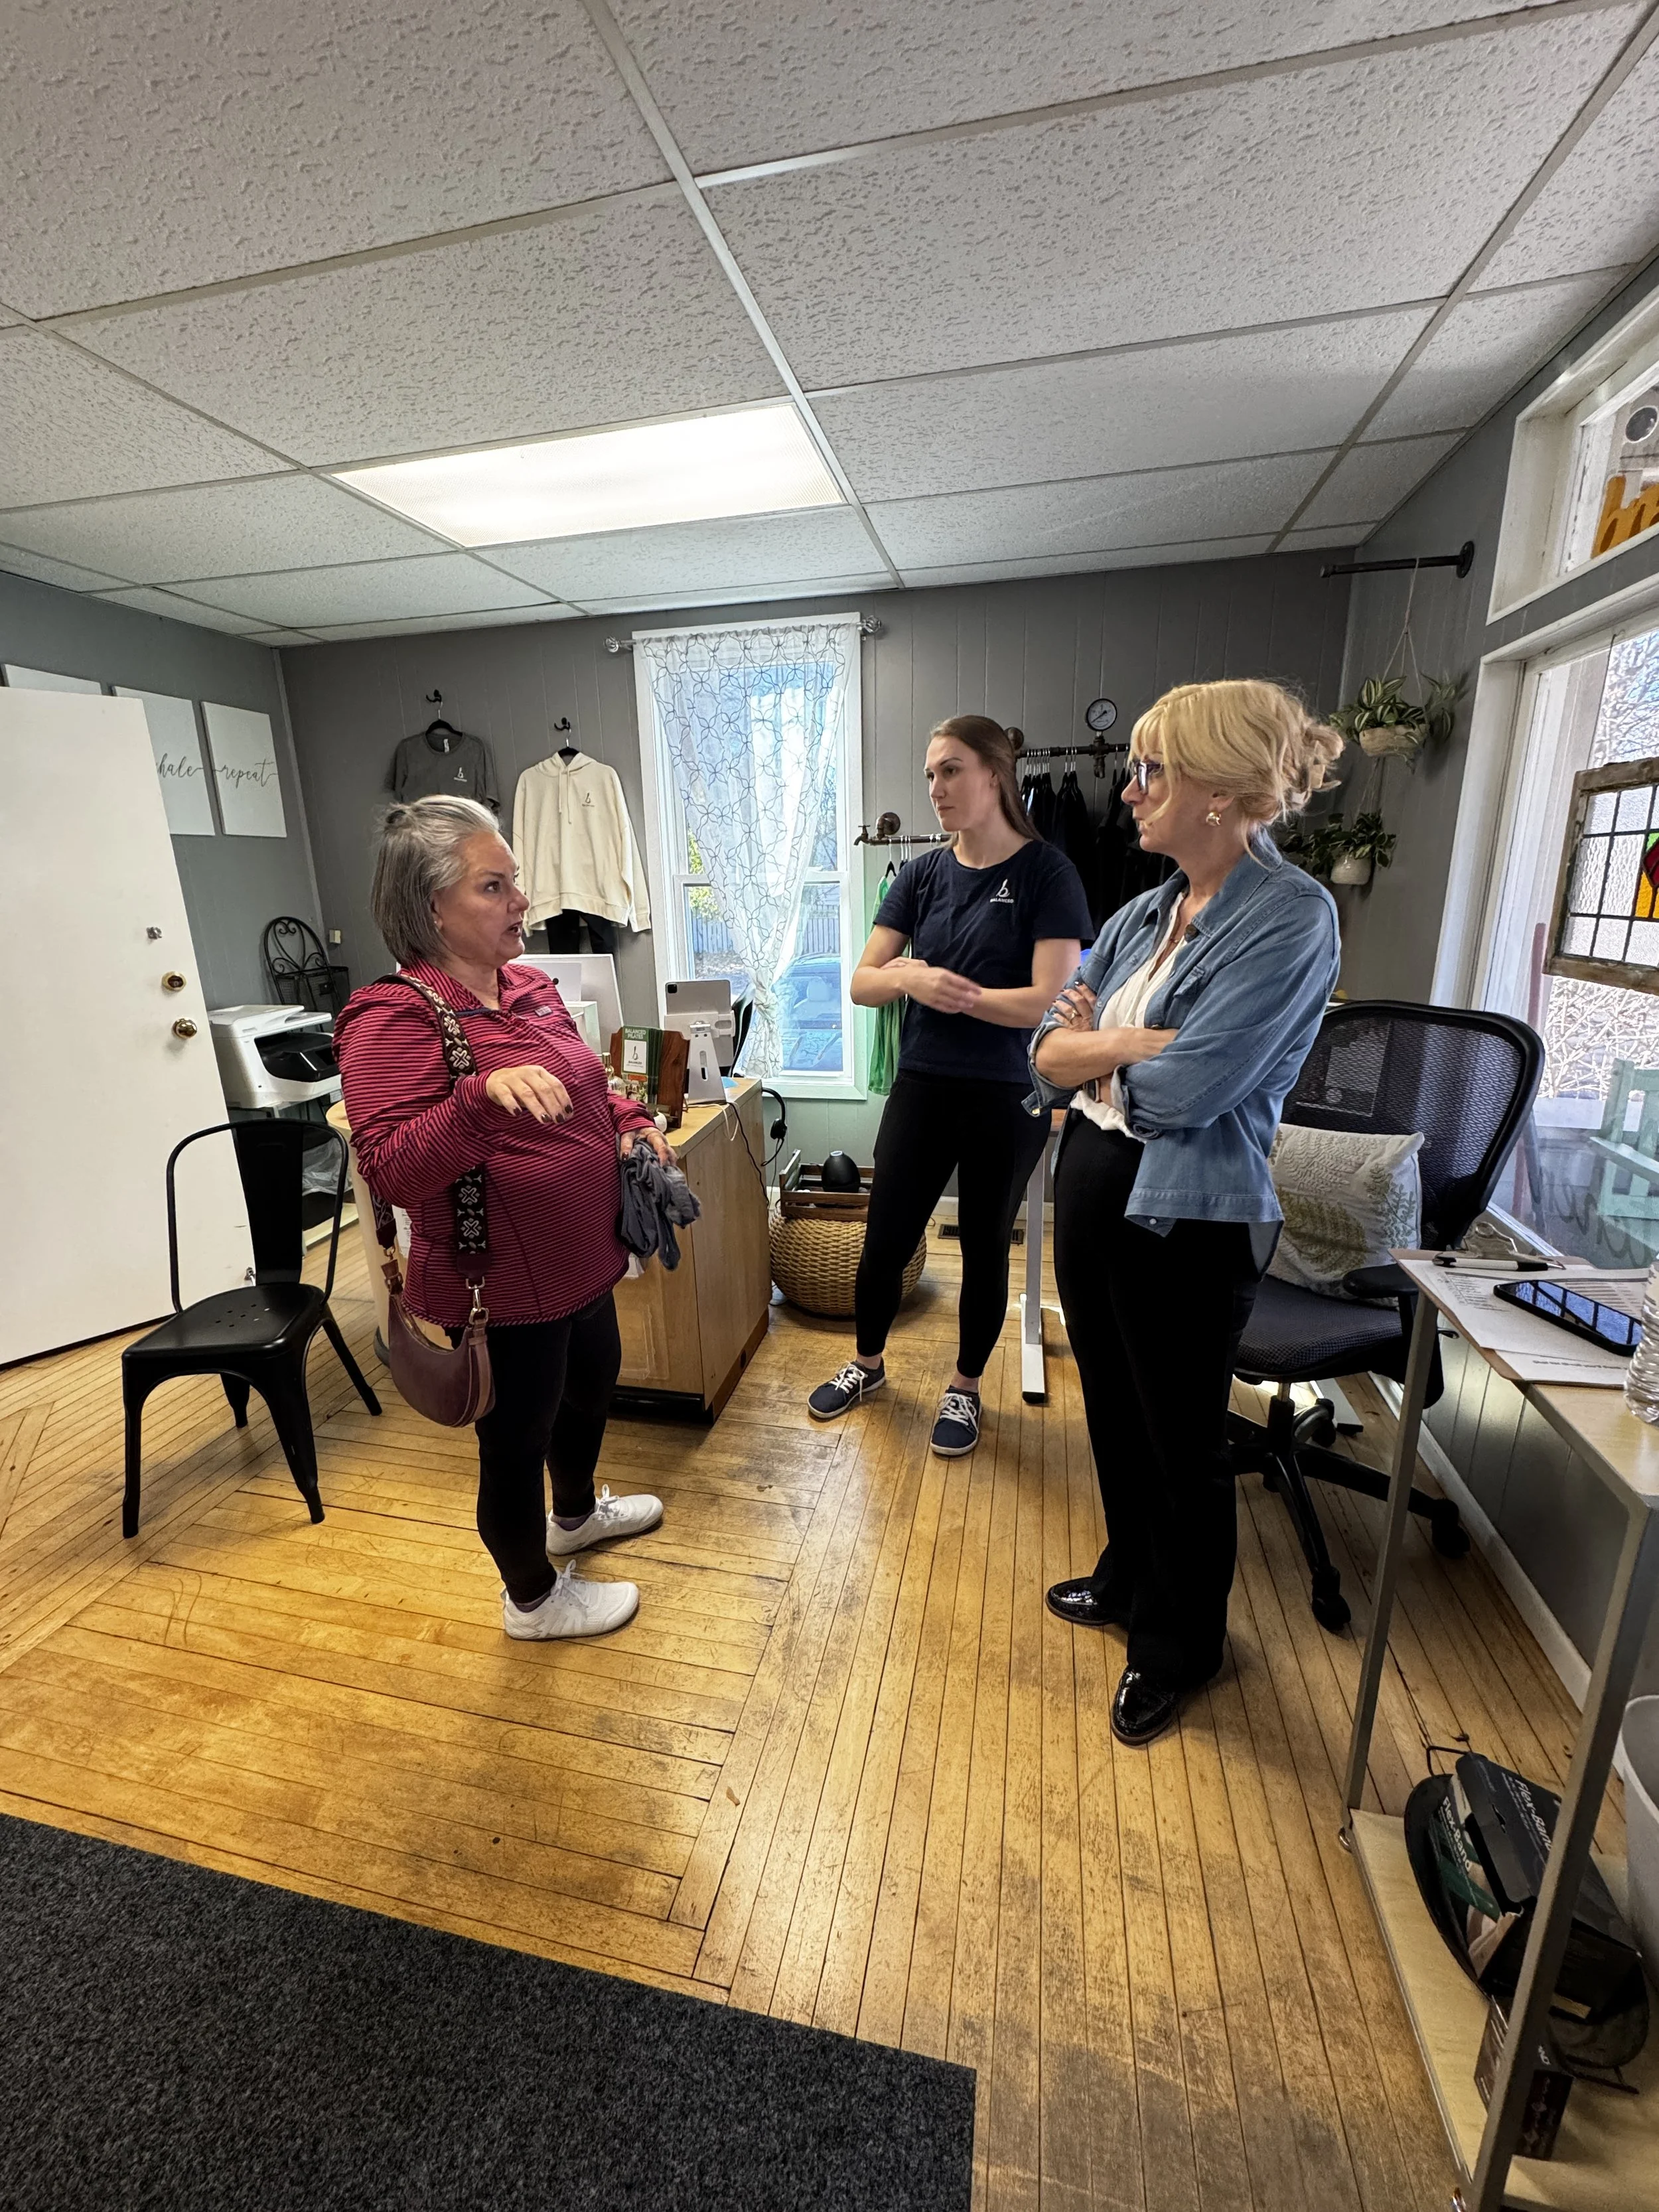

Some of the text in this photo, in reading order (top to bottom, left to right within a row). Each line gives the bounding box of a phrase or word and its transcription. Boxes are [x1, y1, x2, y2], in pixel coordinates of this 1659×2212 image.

[156, 753, 204, 778] hale
[213, 759, 279, 788] repeat
[1443, 1796, 1473, 1872] Flex-Band
